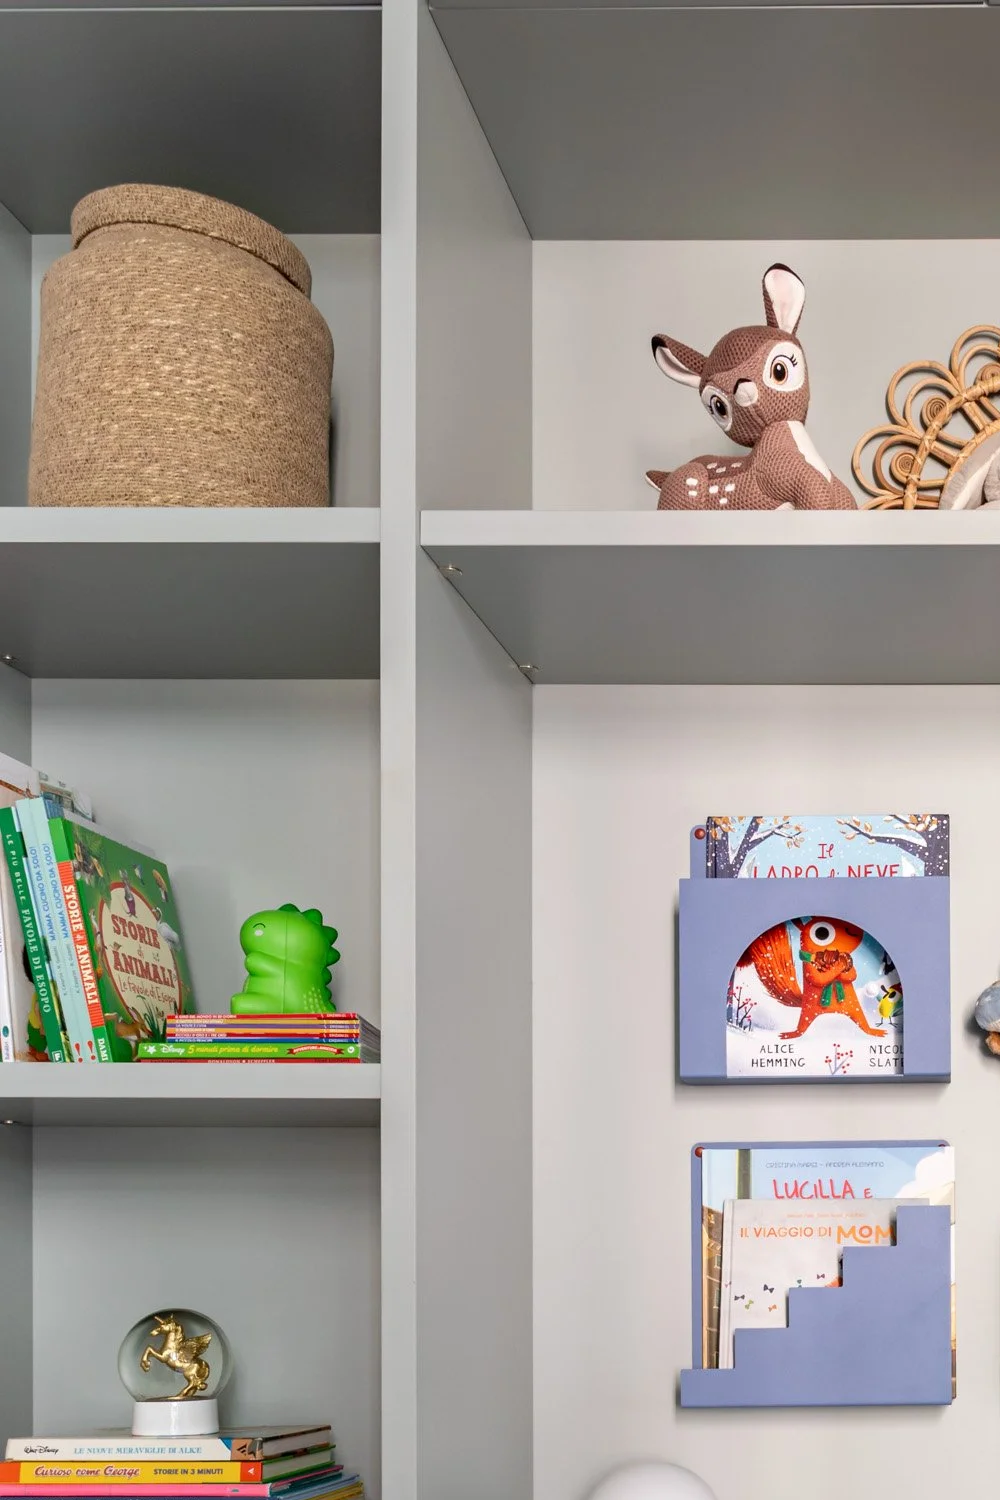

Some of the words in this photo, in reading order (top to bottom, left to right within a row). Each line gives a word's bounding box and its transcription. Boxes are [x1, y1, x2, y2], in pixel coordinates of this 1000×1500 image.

[6, 834, 14, 845] LE
[29, 846, 40, 869] SOLO!
[42, 843, 54, 866] SOLO!
[817, 843, 835, 859] Il
[35, 871, 43, 882] DA
[48, 868, 56, 879] DA
[14, 871, 26, 902] BELLE
[37, 882, 50, 912] CUCINO
[50, 879, 63, 909] CUCINO
[22, 908, 38, 953] FAVOLE
[45, 913, 57, 941] MAMMA
[57, 910, 69, 938] MAMMA
[111, 914, 161, 950] STORIE
[63, 885, 83, 932] STORIE
[76, 944, 99, 1005] ANIMALI
[32, 956, 41, 970] DI
[112, 950, 176, 988] ANIMALI
[36, 974, 51, 1013] ESOPO
[160, 1043, 185, 1055] Disney
[187, 1045, 195, 1054] 5
[196, 1045, 218, 1053] minuti
[219, 1045, 240, 1056] prima
[241, 1045, 249, 1053] di
[250, 1045, 279, 1053] dormire
[759, 1044, 795, 1054] ALICE
[751, 1057, 806, 1068] HEMMING
[772, 1178, 856, 1199] LUCILLA
[740, 1227, 749, 1238] IL
[753, 1226, 814, 1238] VIAGGIO
[818, 1226, 832, 1237] DI
[37, 1445, 59, 1455] Disney
[35, 1465, 72, 1477] Curioso
[75, 1468, 101, 1477] come
[103, 1465, 140, 1479] George
